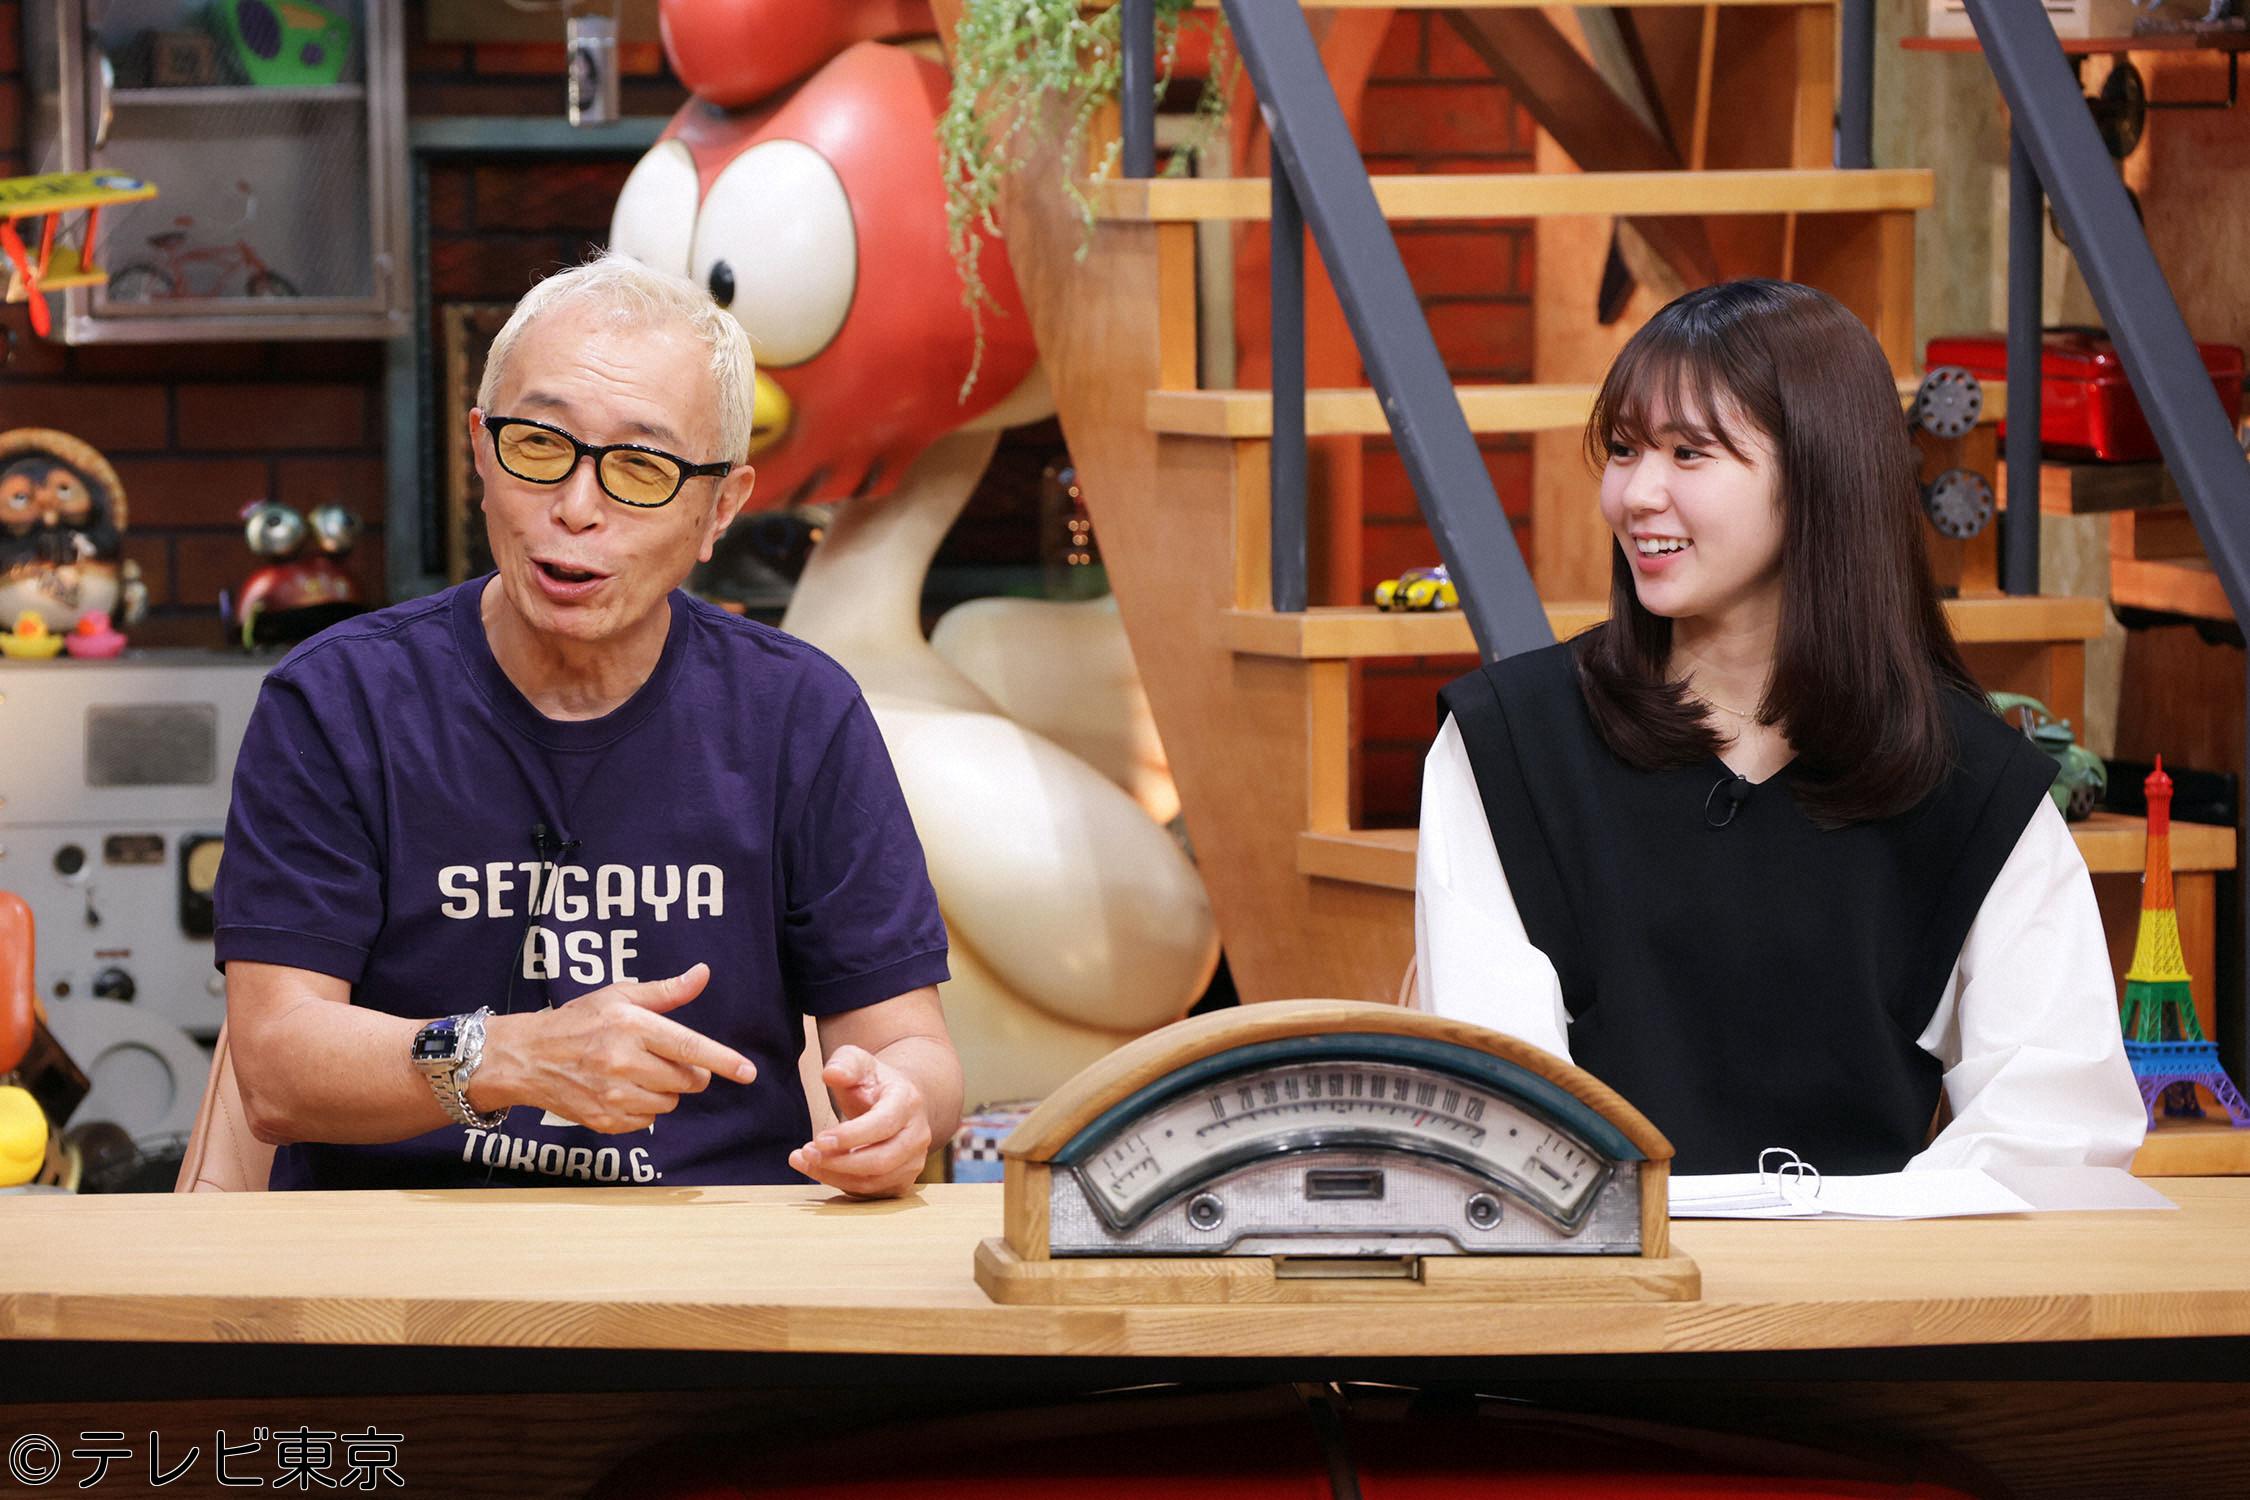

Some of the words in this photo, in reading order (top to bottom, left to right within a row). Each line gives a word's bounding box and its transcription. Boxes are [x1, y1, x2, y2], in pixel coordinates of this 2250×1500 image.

[1208, 1095, 1227, 1120] 10
[1306, 1073, 1322, 1098] 50
[1328, 1073, 1344, 1097] 60
[1416, 1081, 1438, 1107] 100
[1442, 1087, 1462, 1114] 110
[1464, 1096, 1487, 1122] 120
